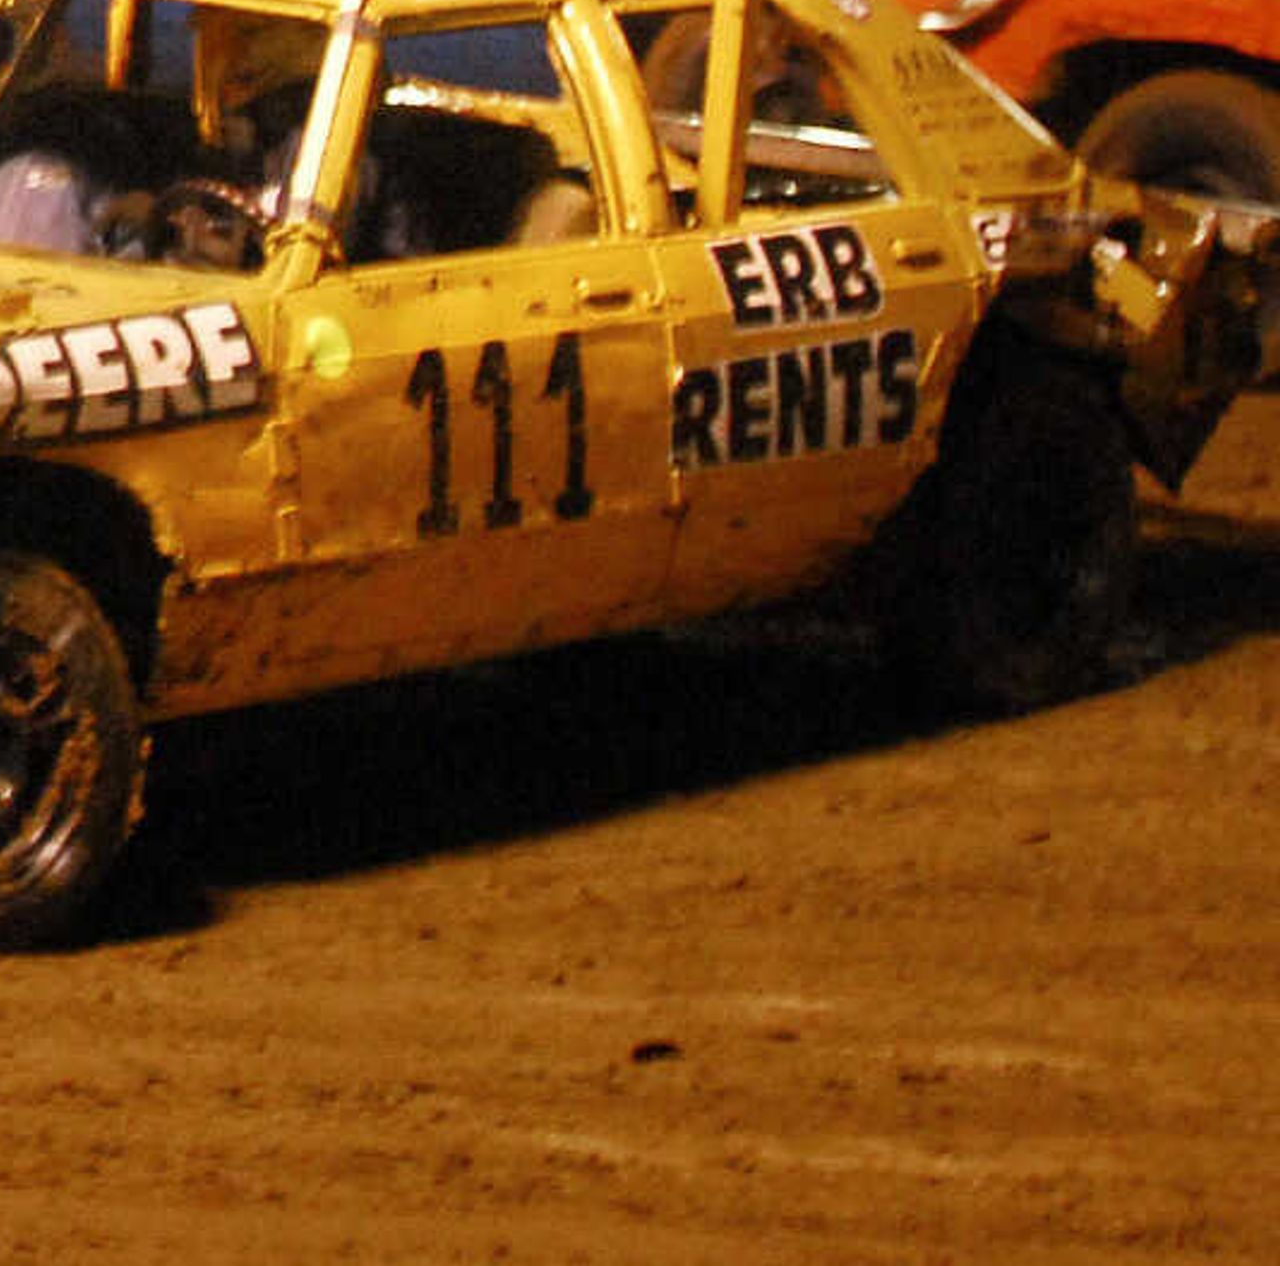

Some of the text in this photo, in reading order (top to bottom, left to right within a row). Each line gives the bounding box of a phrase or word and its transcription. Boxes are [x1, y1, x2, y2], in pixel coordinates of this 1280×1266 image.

[715, 224, 883, 330] ERB
[405, 331, 596, 534] 111
[670, 329, 920, 471] RENTS
